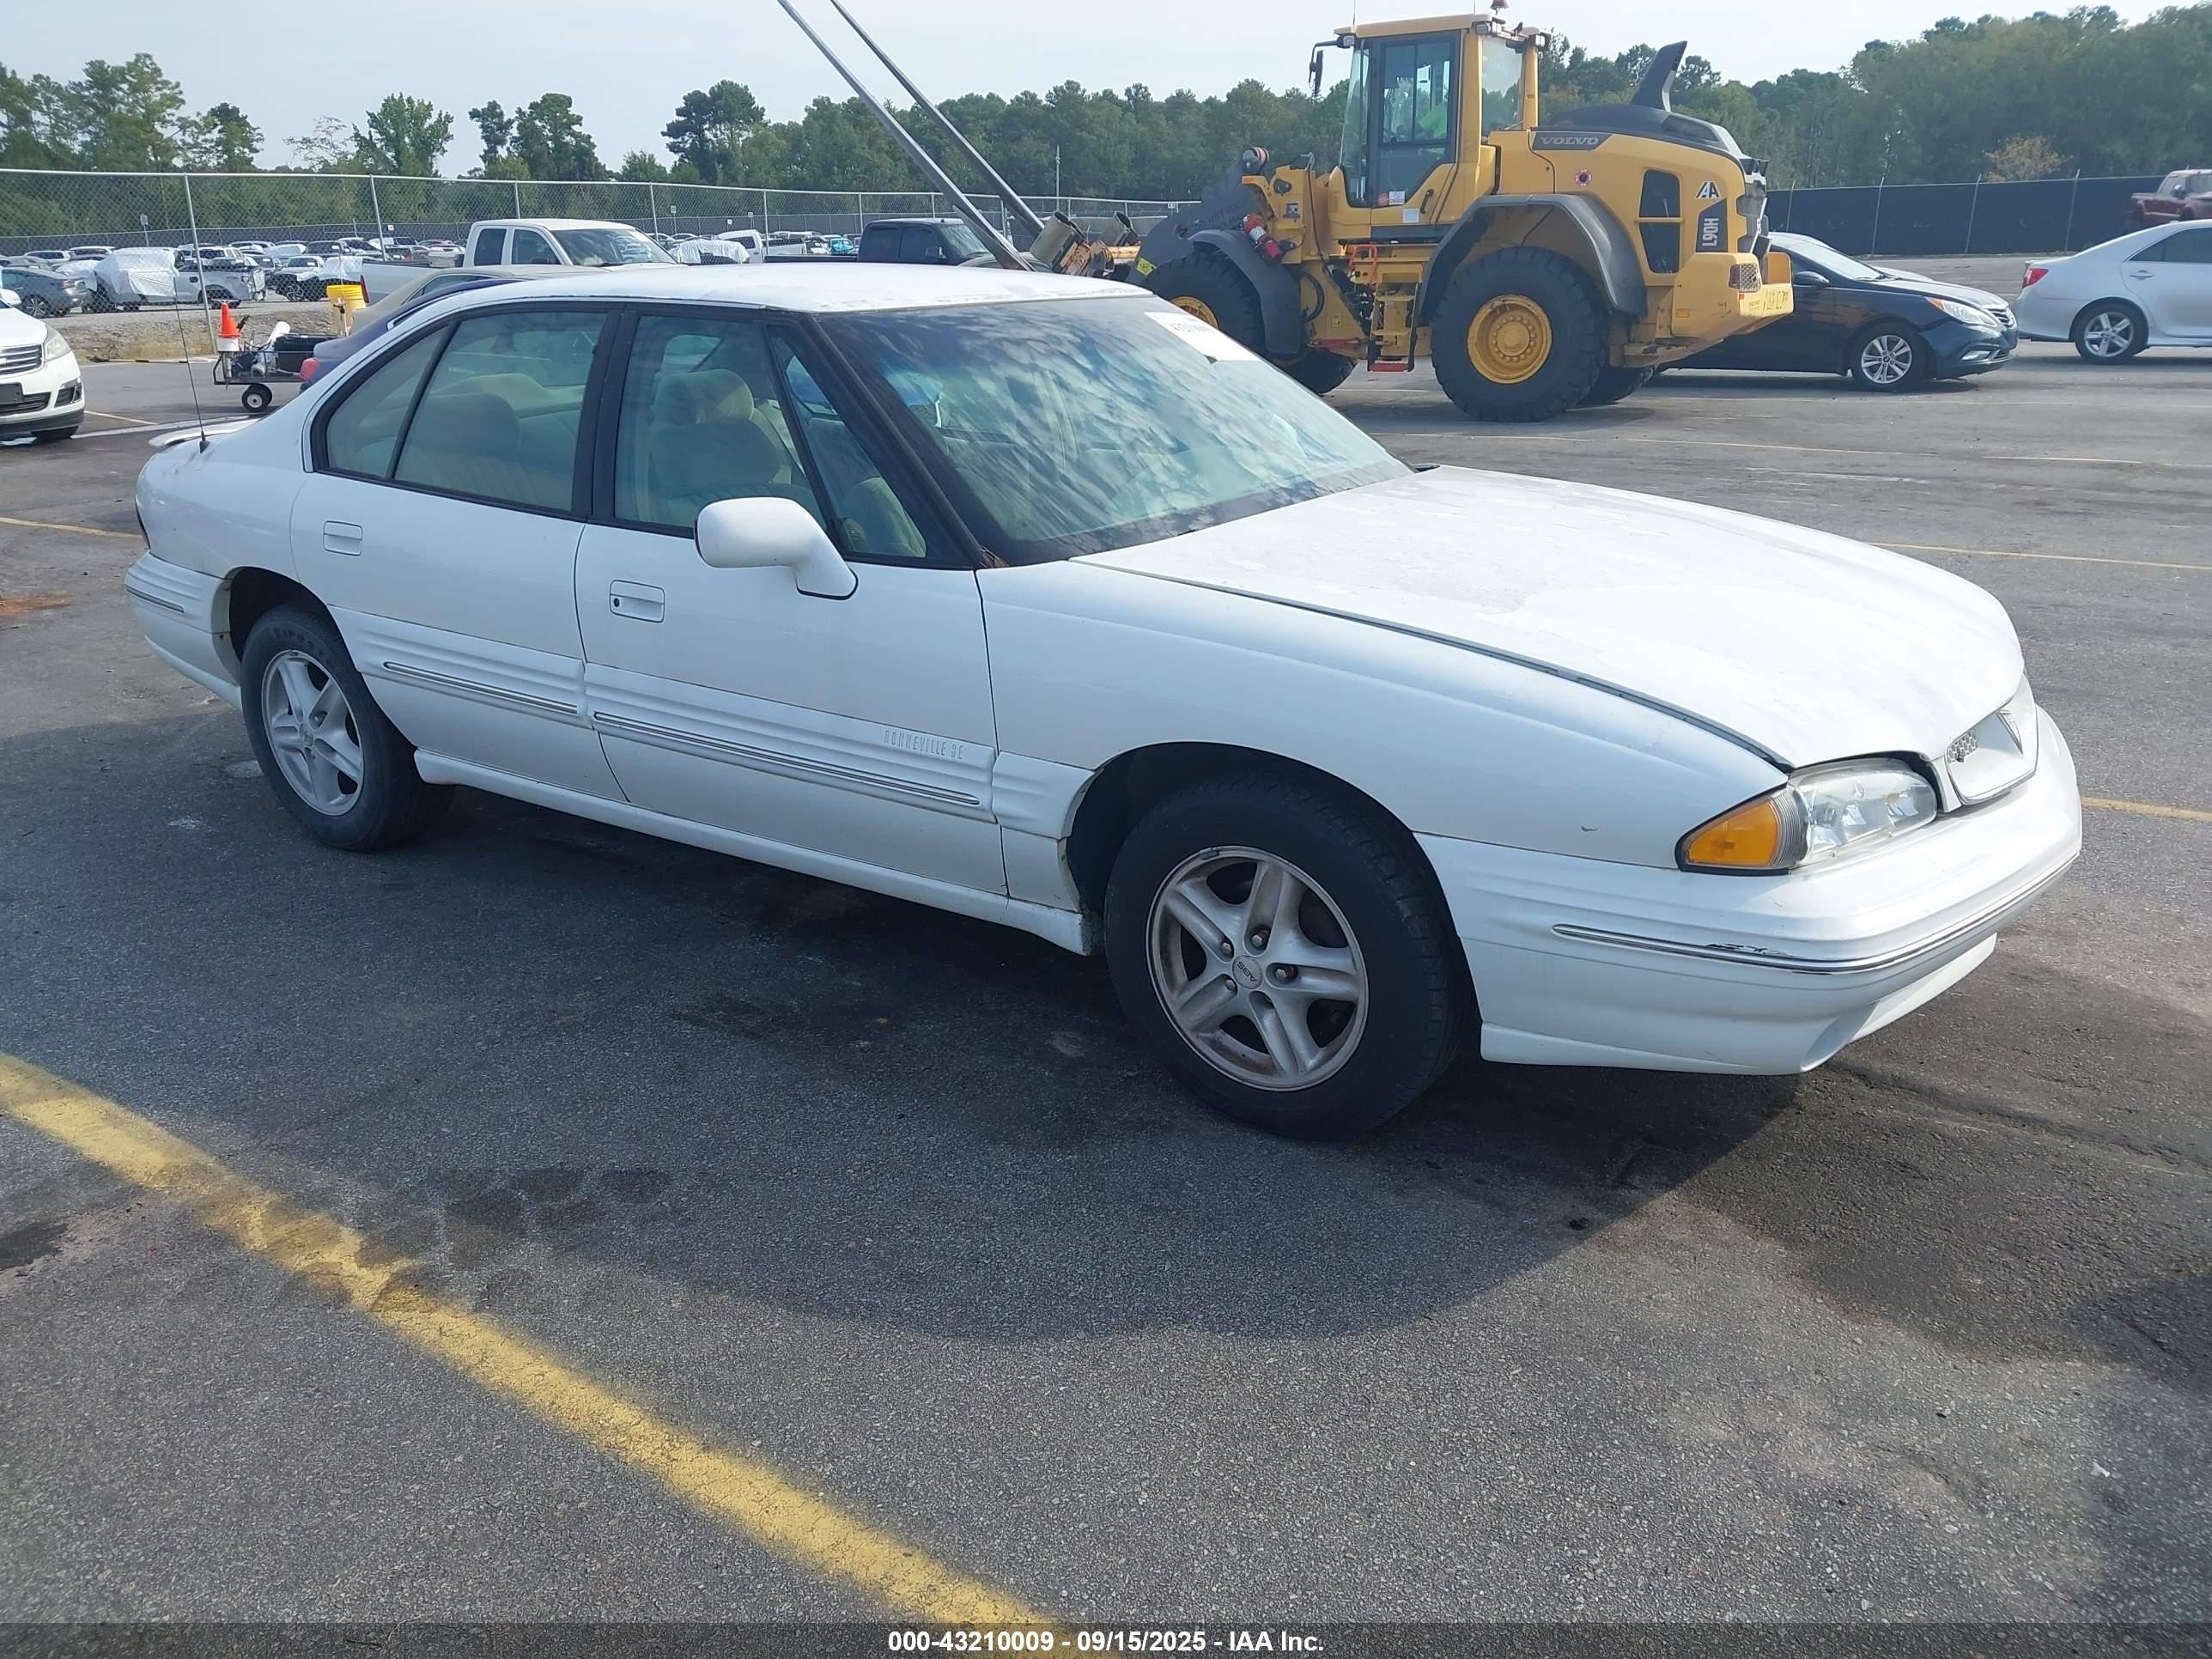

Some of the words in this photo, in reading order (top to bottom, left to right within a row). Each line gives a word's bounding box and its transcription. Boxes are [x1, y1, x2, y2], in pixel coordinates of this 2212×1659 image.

[1540, 137, 1599, 145] VOLVO
[1702, 217, 1719, 246] L90H
[951, 743, 965, 759] SE
